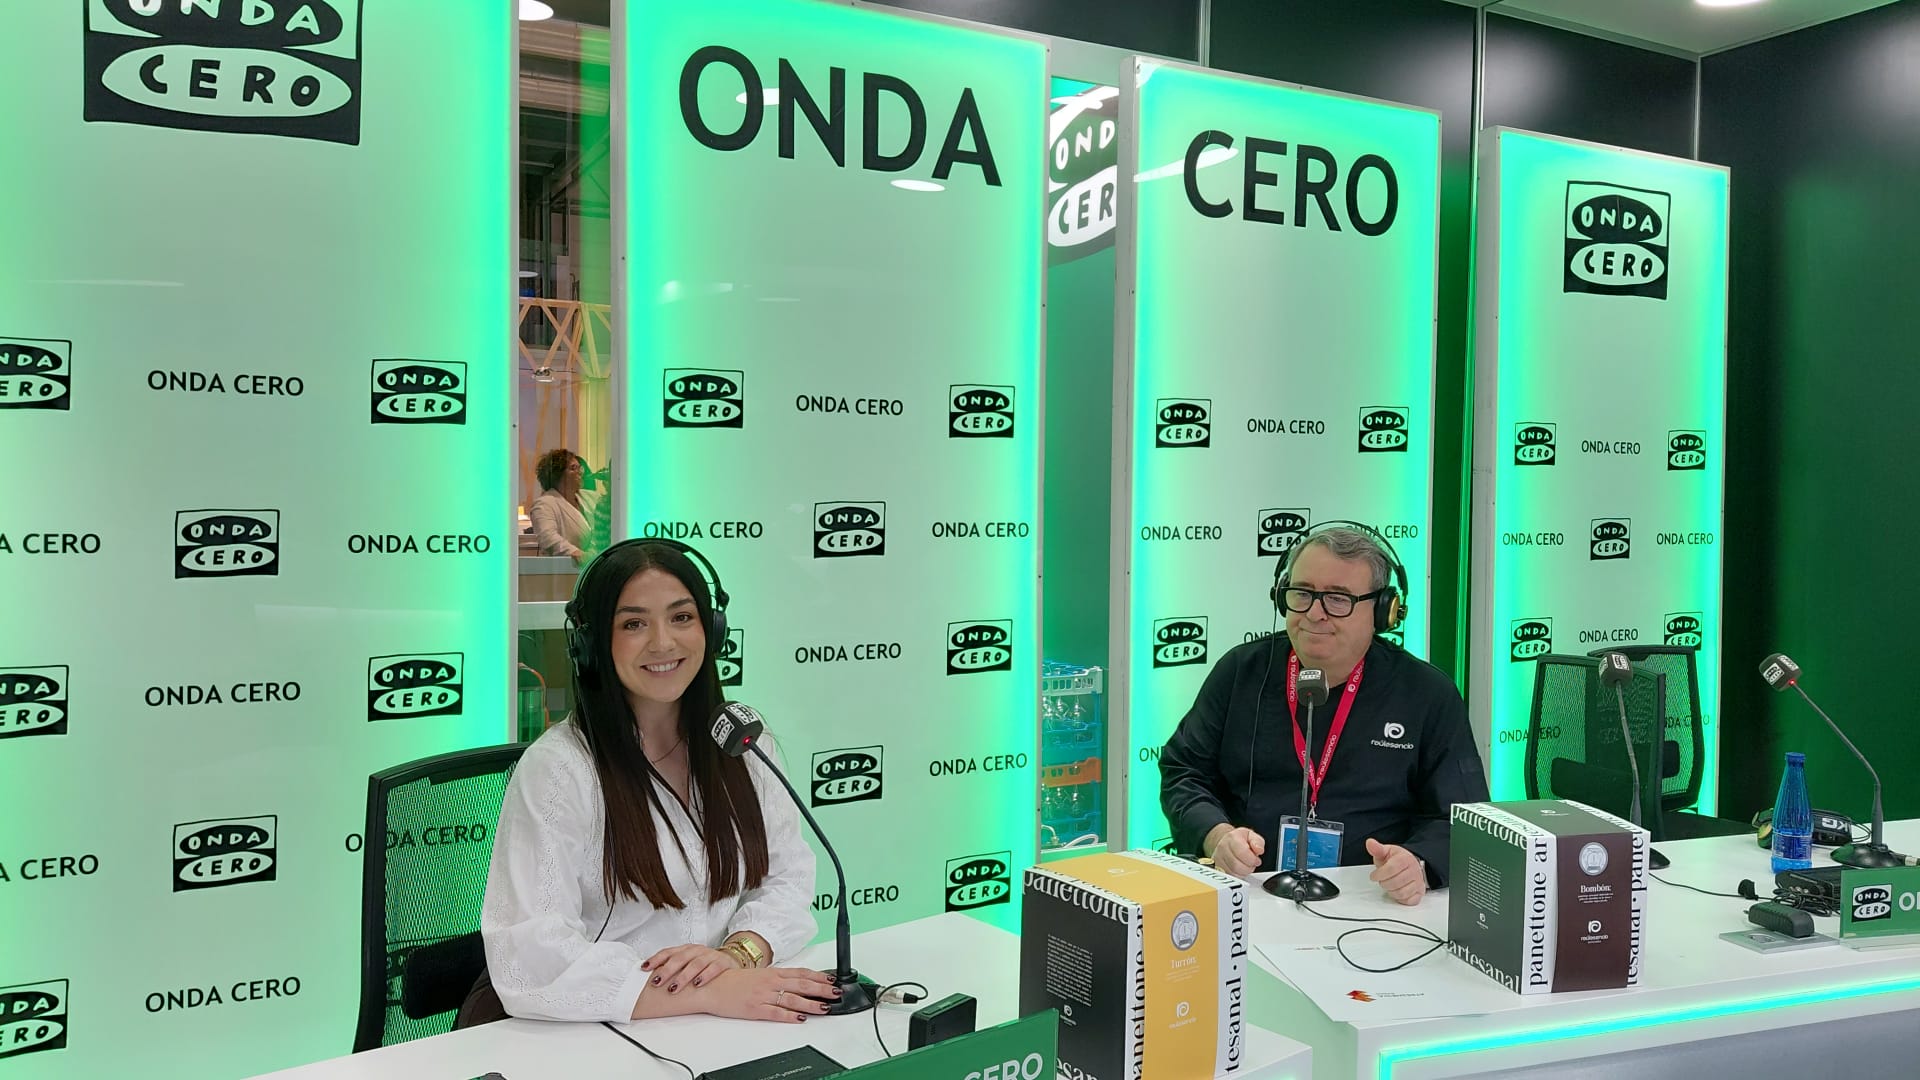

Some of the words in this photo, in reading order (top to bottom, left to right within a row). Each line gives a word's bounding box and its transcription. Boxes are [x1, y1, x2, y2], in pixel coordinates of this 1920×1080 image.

[139, 54, 320, 107] CERO
[679, 46, 1002, 187] ONDA
[1055, 120, 1116, 170] OND
[1184, 130, 1398, 237] CERO
[1059, 182, 1115, 235] CER
[1582, 206, 1653, 233] ONDA
[1584, 250, 1653, 278] CERO
[0, 352, 53, 367] NDA
[147, 370, 226, 393] ONDA
[233, 374, 304, 397] CERO
[386, 373, 452, 386] ONDA
[675, 381, 731, 393] ONDA
[0, 380, 53, 396] ERO
[390, 398, 452, 412] CERO
[796, 394, 850, 414] ONDA
[855, 398, 904, 416] CERO
[959, 396, 1005, 406] ONDA
[679, 404, 731, 417] CERO
[1164, 409, 1202, 419] ONDA
[962, 416, 1004, 428] CERO
[1247, 418, 1286, 434] ONDA
[1289, 419, 1325, 435] CERO
[1367, 416, 1401, 425] ONDA
[1166, 428, 1202, 439] CERO
[1368, 434, 1400, 444] CERO
[1521, 432, 1549, 440] ONDA
[1581, 440, 1611, 454] ONDA
[1613, 441, 1641, 455] CERO
[1674, 439, 1700, 447] ONDA
[1522, 448, 1549, 458] CERO
[1675, 454, 1700, 463] CERO
[825, 514, 874, 525] ONDA
[1266, 519, 1302, 528] ONDA
[191, 524, 263, 538] ONDA
[643, 521, 704, 539] ONDA
[709, 521, 763, 539] CERO
[931, 522, 981, 538] ONDA
[985, 522, 1029, 538] CERO
[1141, 525, 1181, 541] ONDA
[1185, 525, 1222, 541] CERO
[1384, 525, 1419, 539] CERO
[1597, 527, 1624, 536] ONDA
[22, 533, 101, 554] CERO
[347, 534, 419, 554] ONDA
[426, 534, 491, 554] CERO
[828, 534, 874, 547] CERO
[1502, 532, 1533, 546] ONDA
[1535, 532, 1564, 546] CERO
[1656, 532, 1685, 546] ONDA
[1687, 532, 1714, 545] CERO
[1598, 543, 1624, 552] CERO
[195, 550, 263, 565] CERO
[1162, 627, 1199, 639] ONDA
[1517, 627, 1546, 637] ONDA
[1670, 621, 1696, 630] ONDA
[957, 631, 1002, 643] ONDA
[1579, 630, 1609, 643] ONDA
[1611, 628, 1638, 642] CERO
[795, 645, 848, 664] ONDA
[853, 642, 902, 661] CERO
[1164, 646, 1199, 658] CERO
[1519, 643, 1545, 654] CERO
[959, 651, 1002, 664] CERO
[382, 667, 448, 682] ONDA
[144, 684, 223, 707] ONDA
[230, 681, 301, 703] CERO
[386, 692, 448, 708] CERO
[822, 759, 871, 774] ONDA
[929, 757, 977, 777] ONDA
[982, 752, 1027, 772] CERO
[825, 780, 872, 795] CERO
[1451, 804, 1528, 850] panettone
[189, 831, 260, 850] ONDA
[345, 830, 416, 852] ODA
[423, 823, 487, 846] CERO
[1534, 837, 1547, 863] ar
[20, 854, 99, 880] CERO
[193, 858, 261, 877] CERO
[955, 864, 1001, 880] ONDA
[851, 885, 899, 906] CERO
[958, 885, 1000, 901] CERO
[1023, 870, 1129, 925] panettone
[1858, 892, 1886, 901] ONDA
[1859, 906, 1885, 915] CERO
[1529, 872, 1548, 987] panettone
[1450, 939, 1522, 994] artesanal
[145, 985, 224, 1013] ONDA
[230, 976, 301, 1003] CERO
